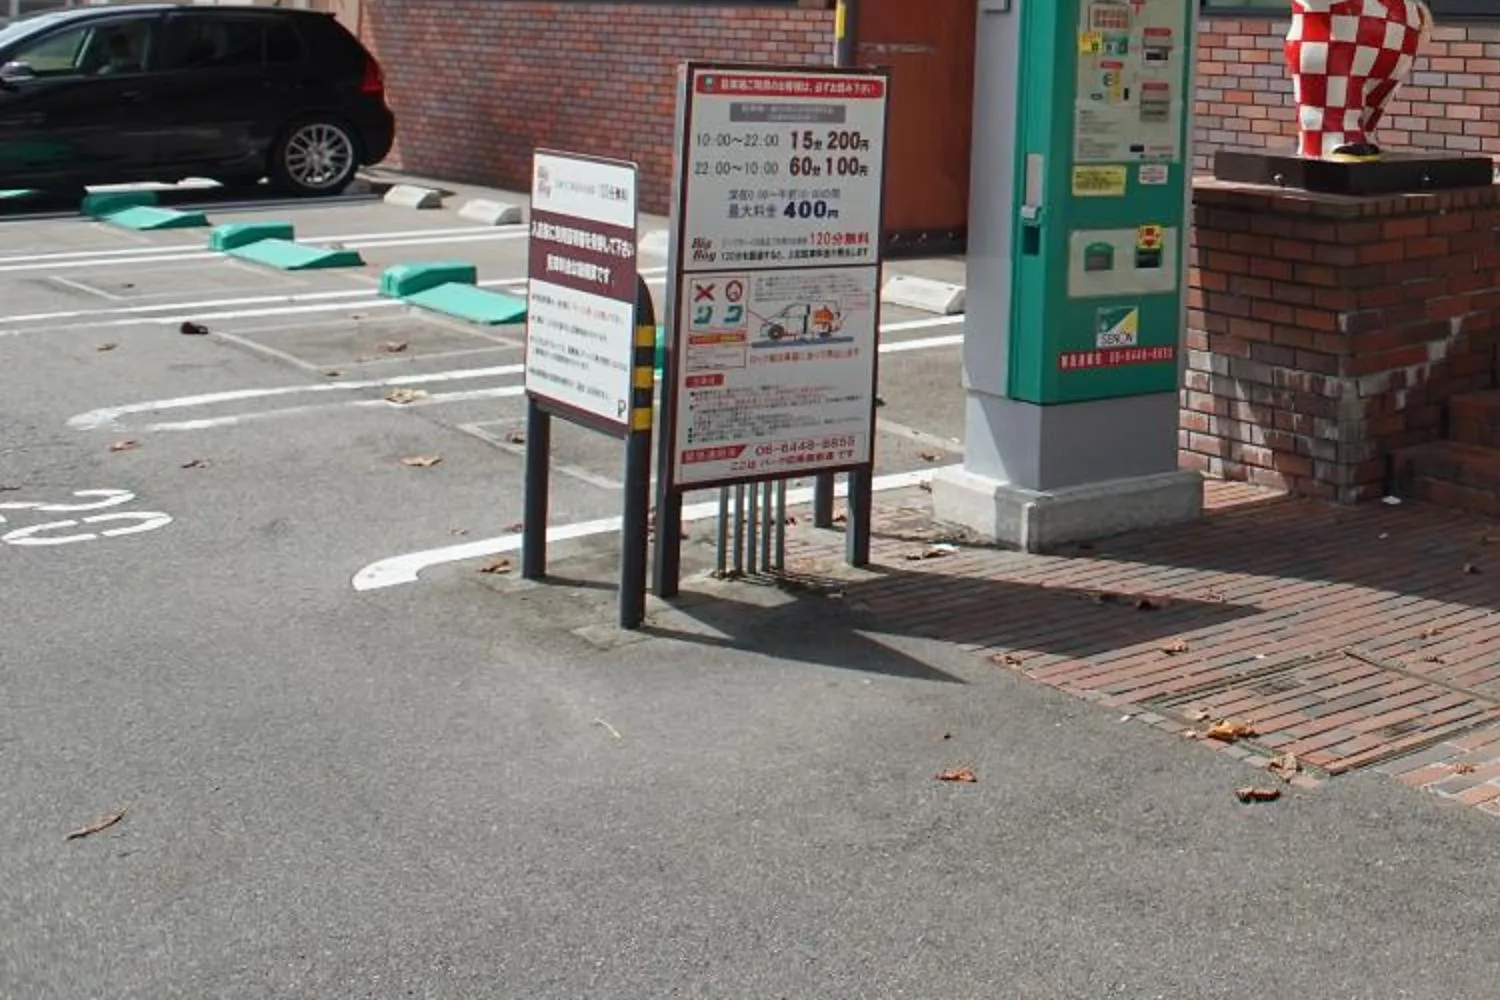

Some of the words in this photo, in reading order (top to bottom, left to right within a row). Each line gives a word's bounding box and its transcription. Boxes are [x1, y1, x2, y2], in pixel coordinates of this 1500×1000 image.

[790, 131, 823, 150] 15分
[827, 131, 870, 151] 200円
[789, 156, 822, 177] 60分
[825, 157, 869, 177] 100円
[783, 200, 839, 219] 400円
